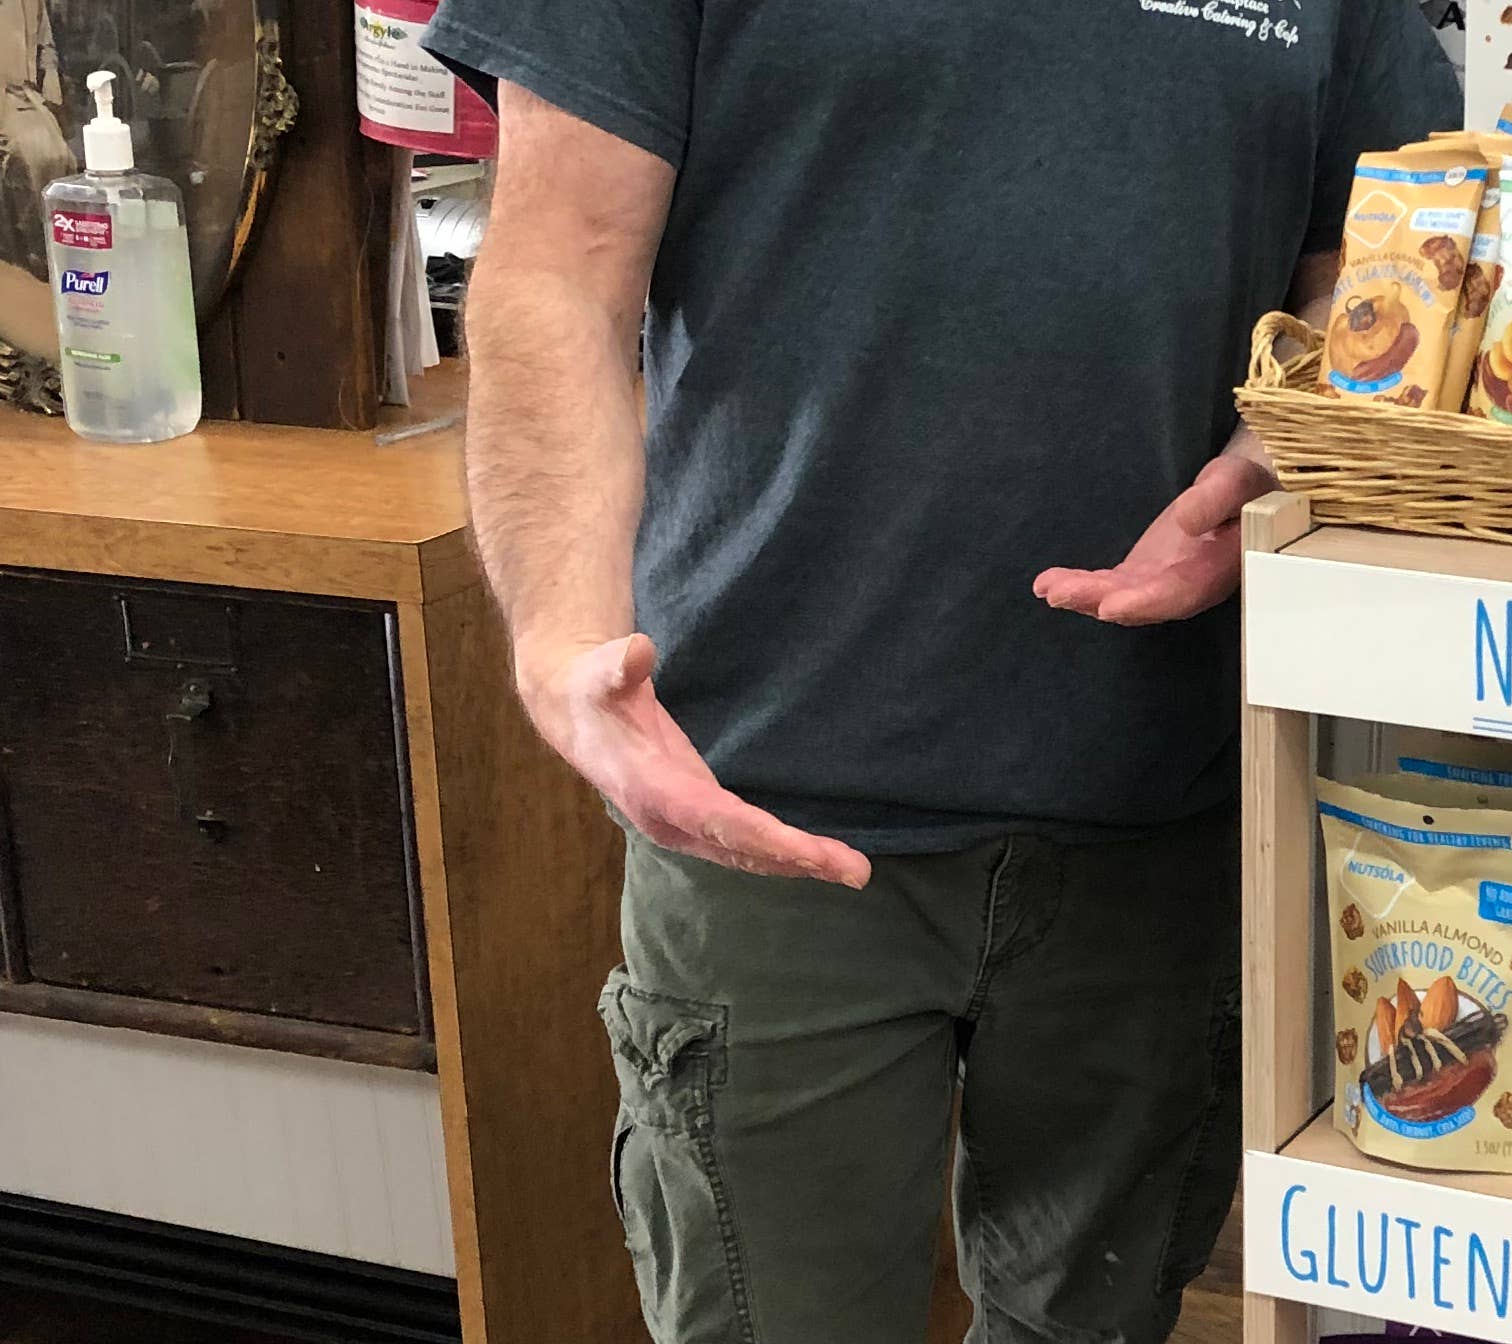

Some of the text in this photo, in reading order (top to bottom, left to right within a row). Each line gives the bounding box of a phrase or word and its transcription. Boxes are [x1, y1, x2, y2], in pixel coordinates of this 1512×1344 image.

[1201, 1, 1256, 38] Catering
[1258, 18, 1272, 41] &
[54, 213, 75, 232] 2X
[66, 272, 104, 293] Purell
